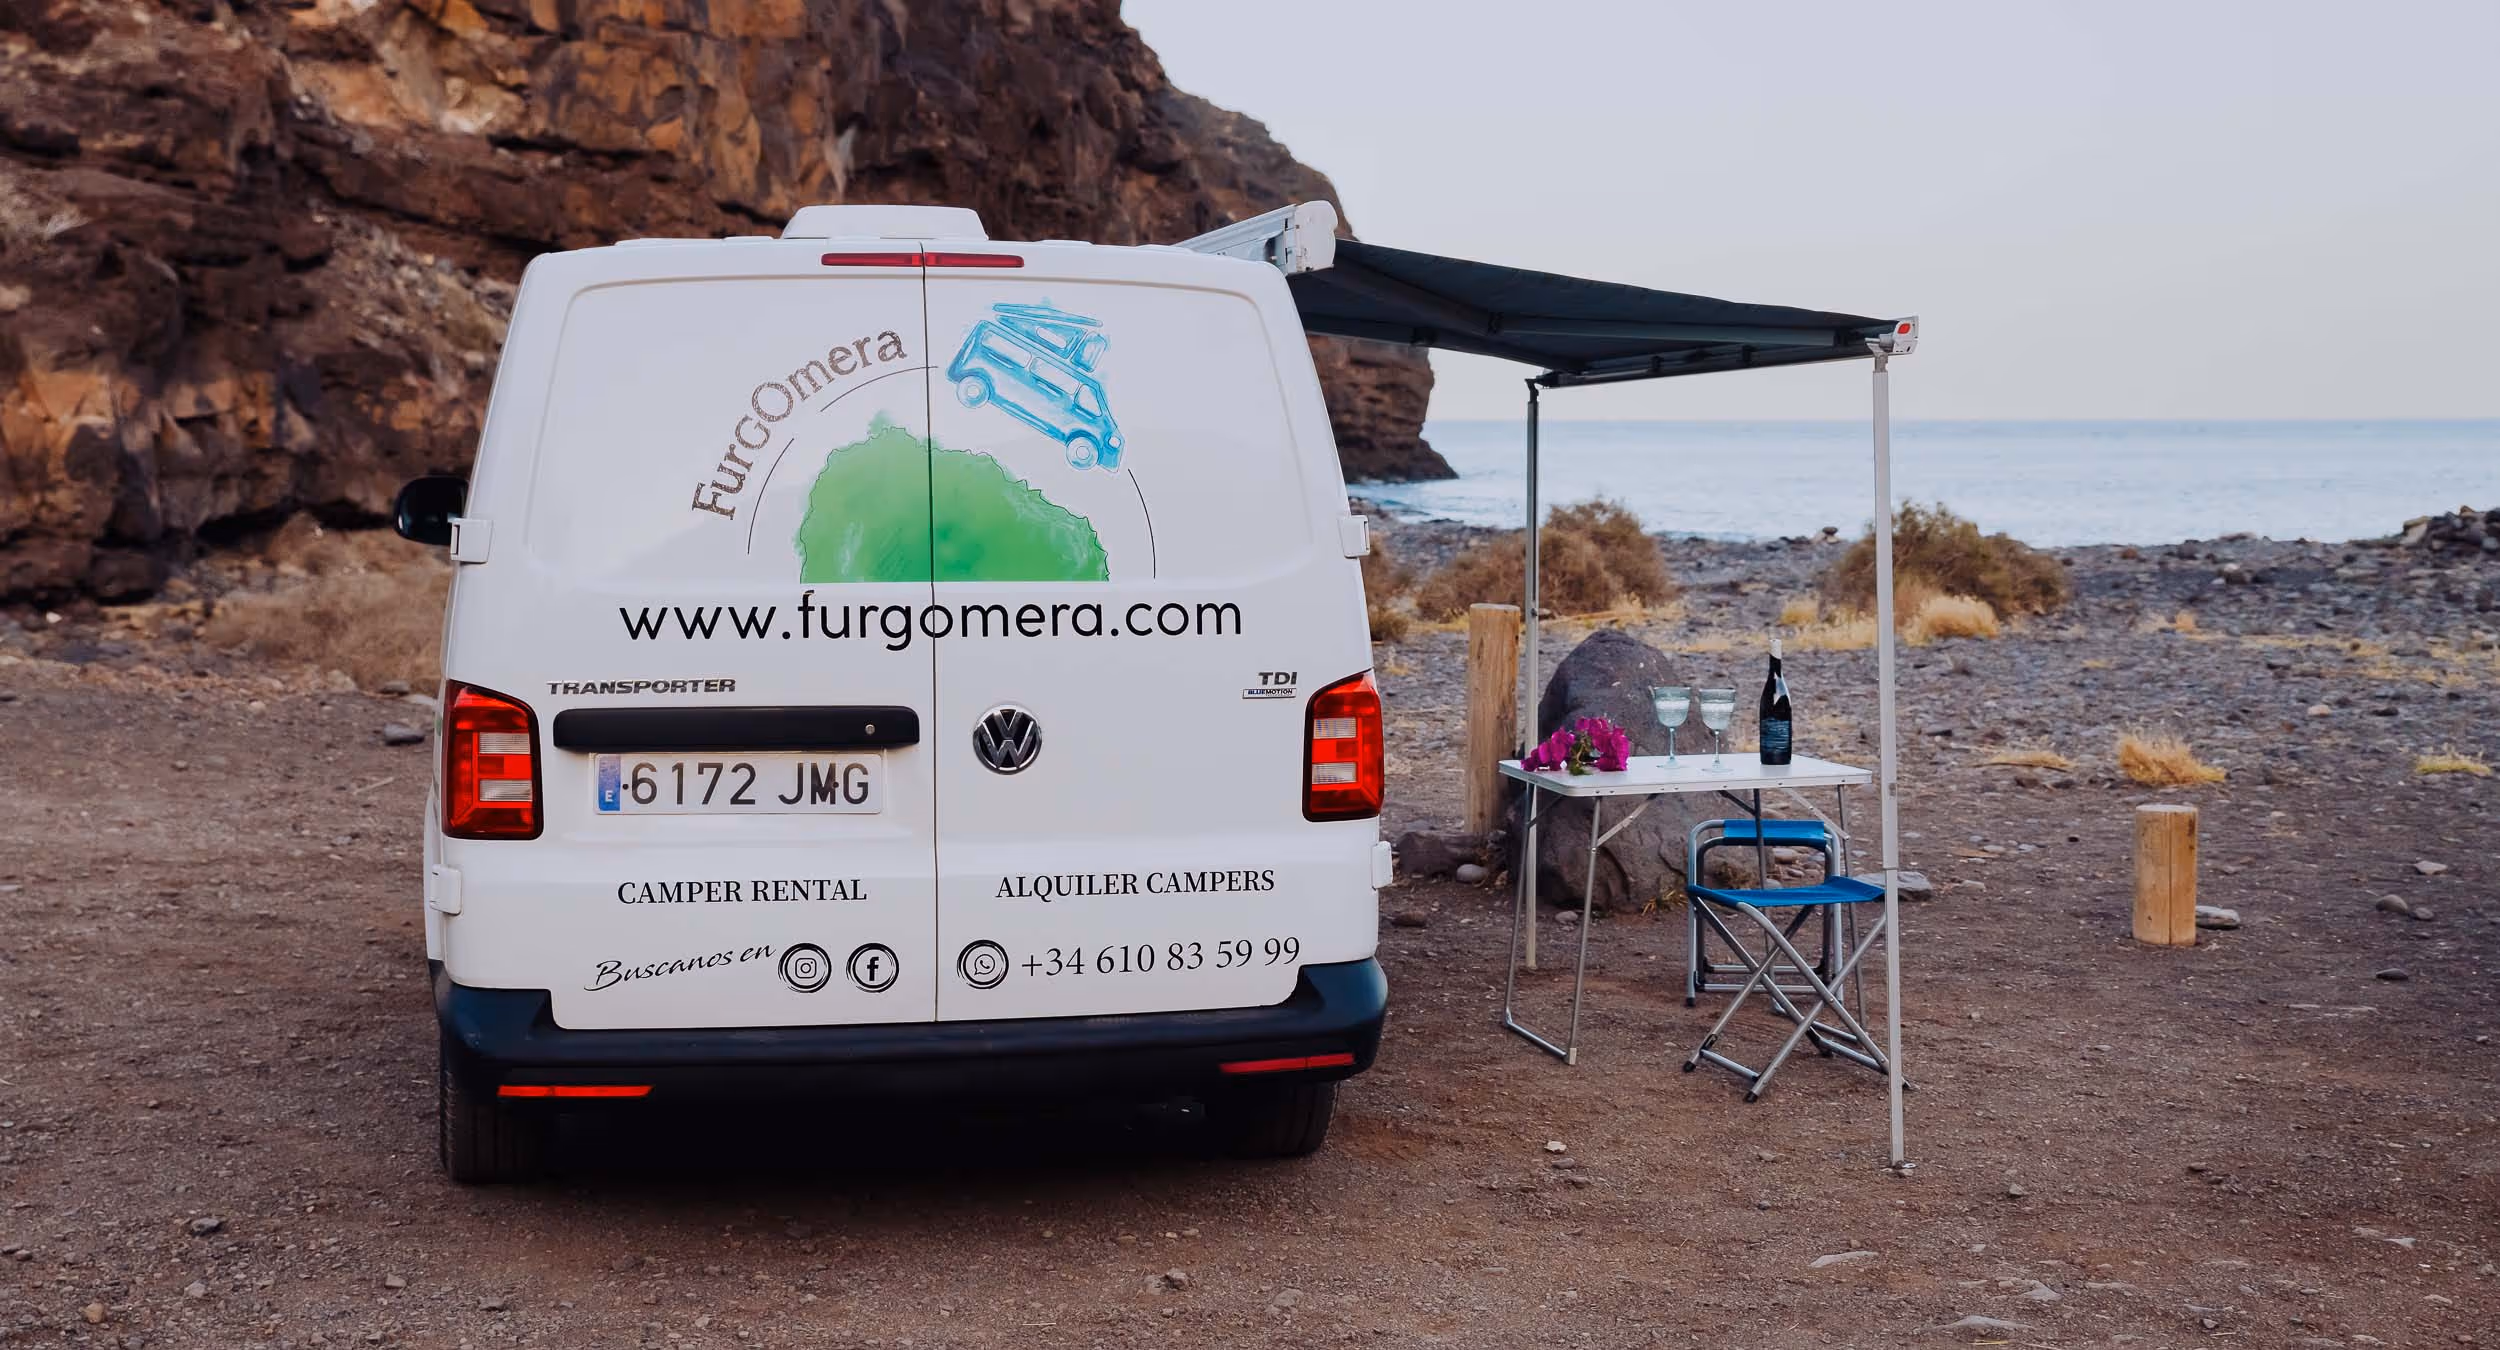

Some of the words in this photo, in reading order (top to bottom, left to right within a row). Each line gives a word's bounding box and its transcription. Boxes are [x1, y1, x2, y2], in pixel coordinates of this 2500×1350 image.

[619, 591, 1242, 651] www.furgomera.com
[547, 678, 736, 695] TRANSPORTER
[1258, 671, 1298, 686] TDI
[631, 762, 757, 805] 6172
[777, 762, 869, 805] JMG
[617, 880, 744, 905] CAMPER
[751, 879, 867, 902] RENTAL
[995, 873, 1140, 903] ALQUILER
[1146, 869, 1275, 894] CAMPERS
[583, 950, 734, 992] Buscanos
[739, 944, 777, 963] en
[1021, 946, 1085, 977] +34
[1096, 944, 1155, 974] 610
[1167, 941, 1204, 971] 83
[1215, 939, 1253, 969] 59
[1264, 936, 1300, 966] 99
